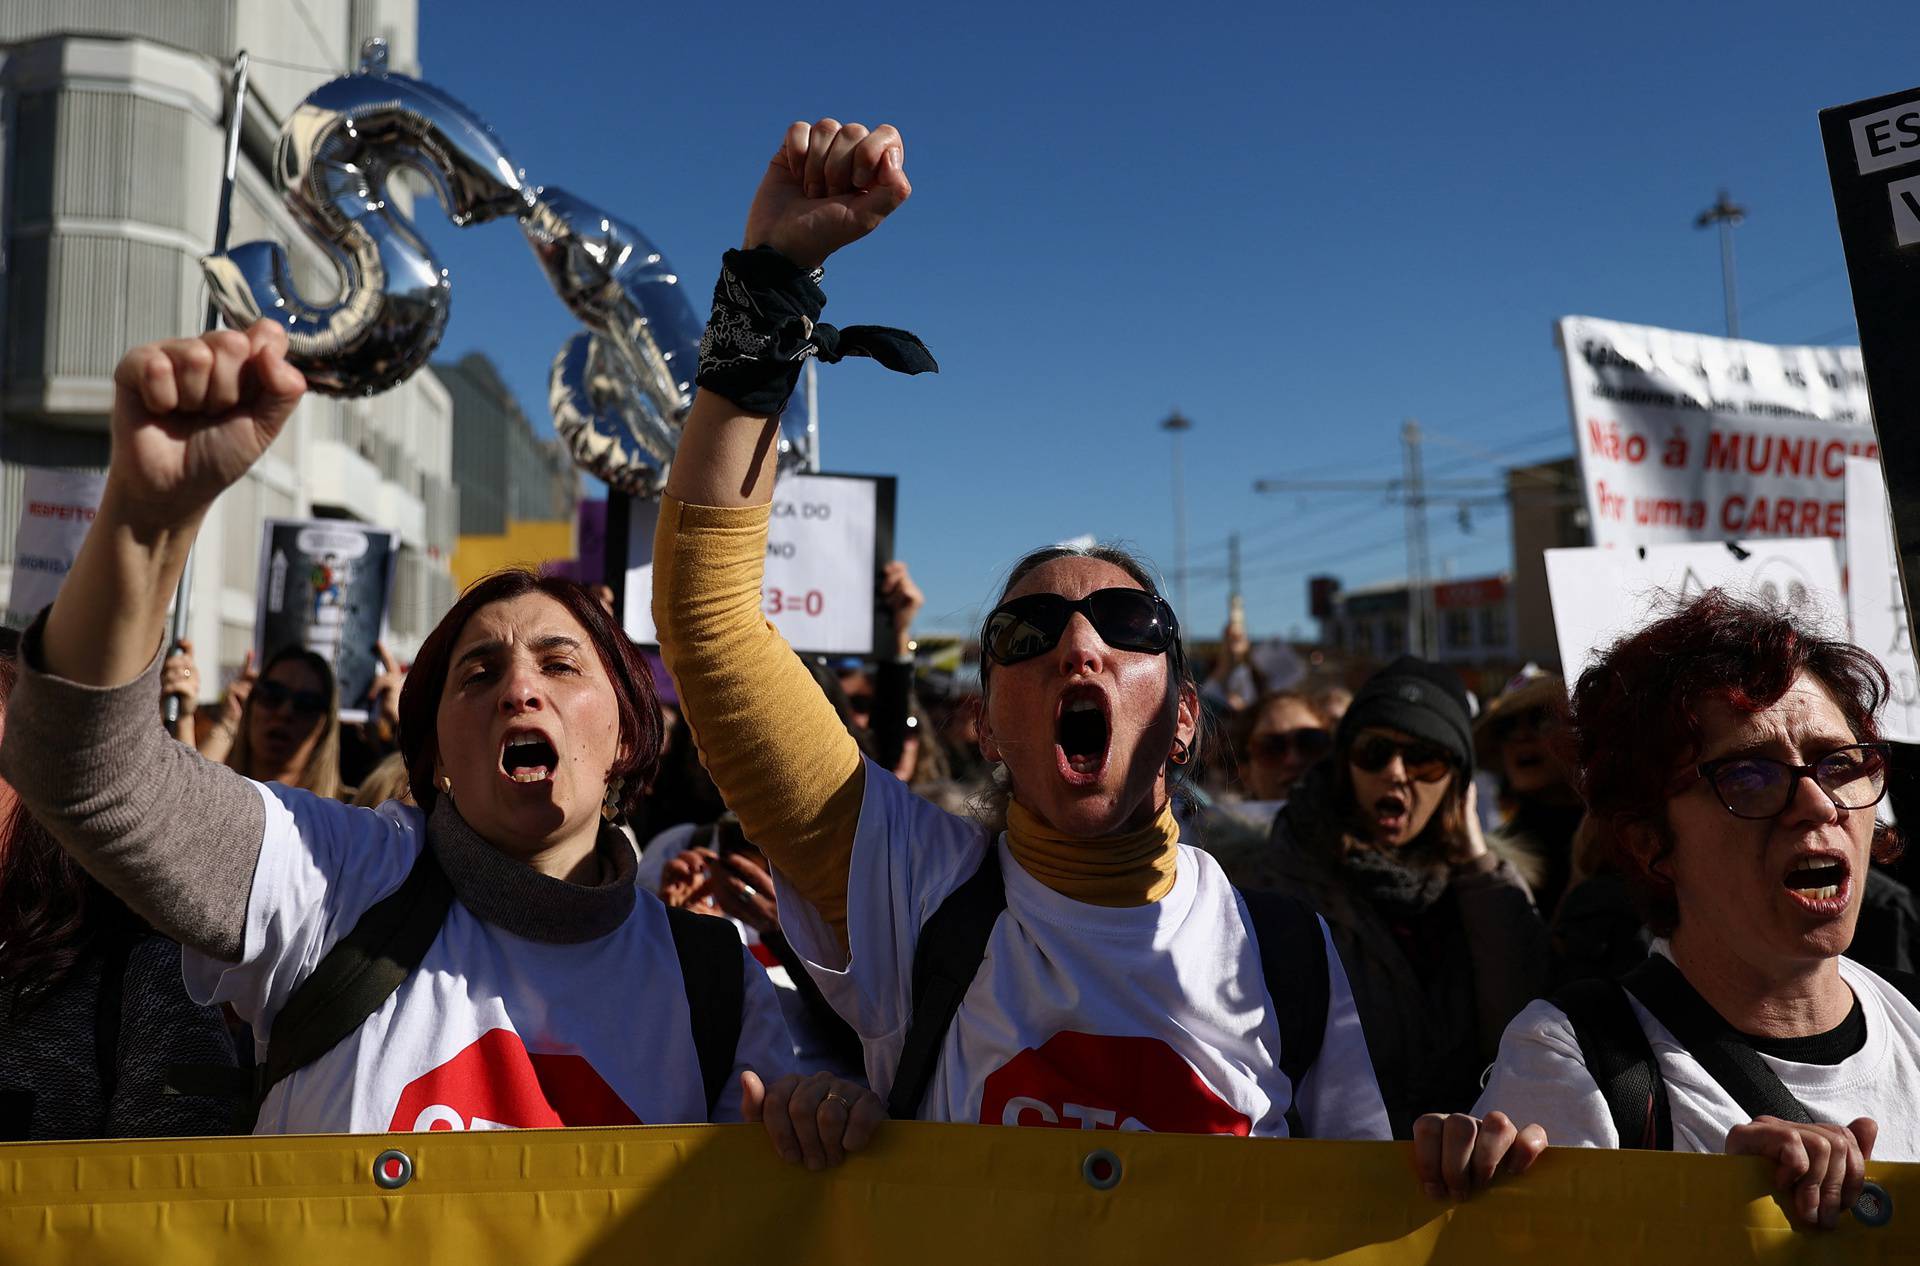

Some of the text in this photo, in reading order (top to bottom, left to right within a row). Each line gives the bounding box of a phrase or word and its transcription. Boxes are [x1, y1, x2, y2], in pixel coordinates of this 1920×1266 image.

[802, 501, 831, 521] DO
[1634, 497, 1707, 531] uma
[760, 586, 824, 618] 3=0
